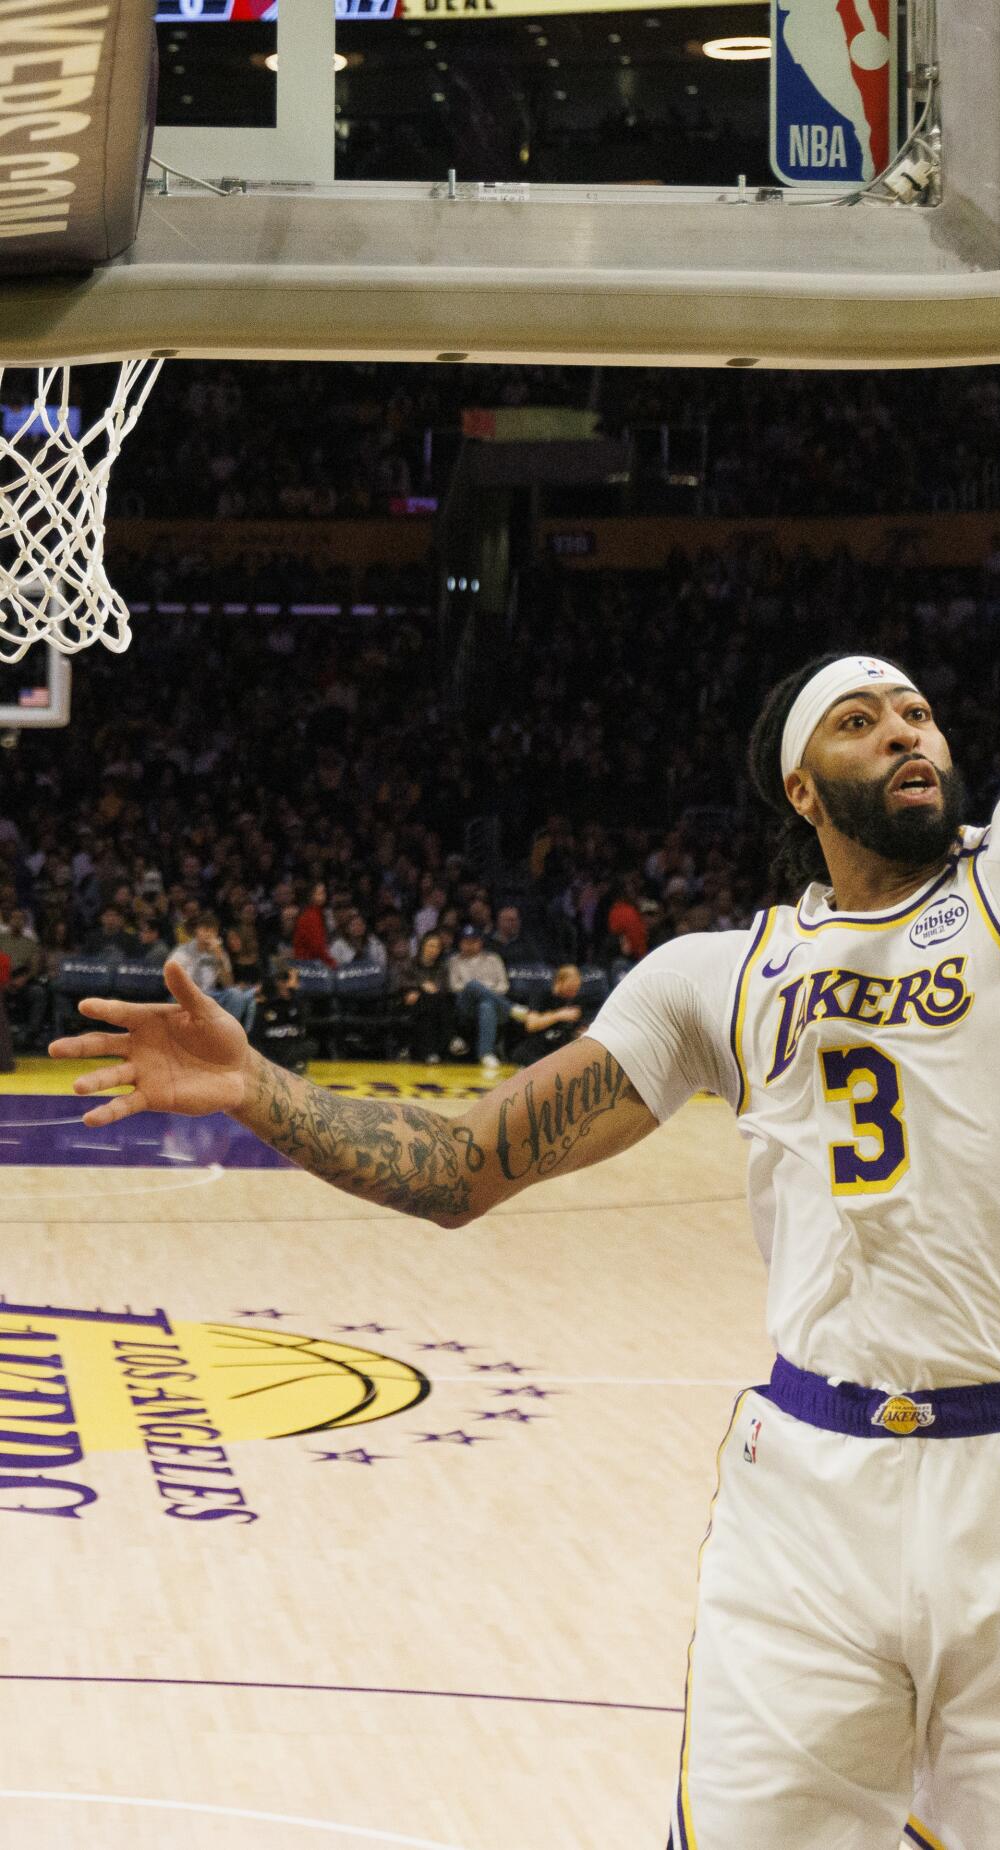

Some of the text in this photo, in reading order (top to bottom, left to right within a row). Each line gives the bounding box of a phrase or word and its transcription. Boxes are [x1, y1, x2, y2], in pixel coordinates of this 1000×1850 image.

[789, 124, 848, 168] NBA
[819, 1042, 910, 1196] 3
[112, 1340, 259, 1525] LOS ANGELES
[875, 1404, 936, 1427] LAKERS
